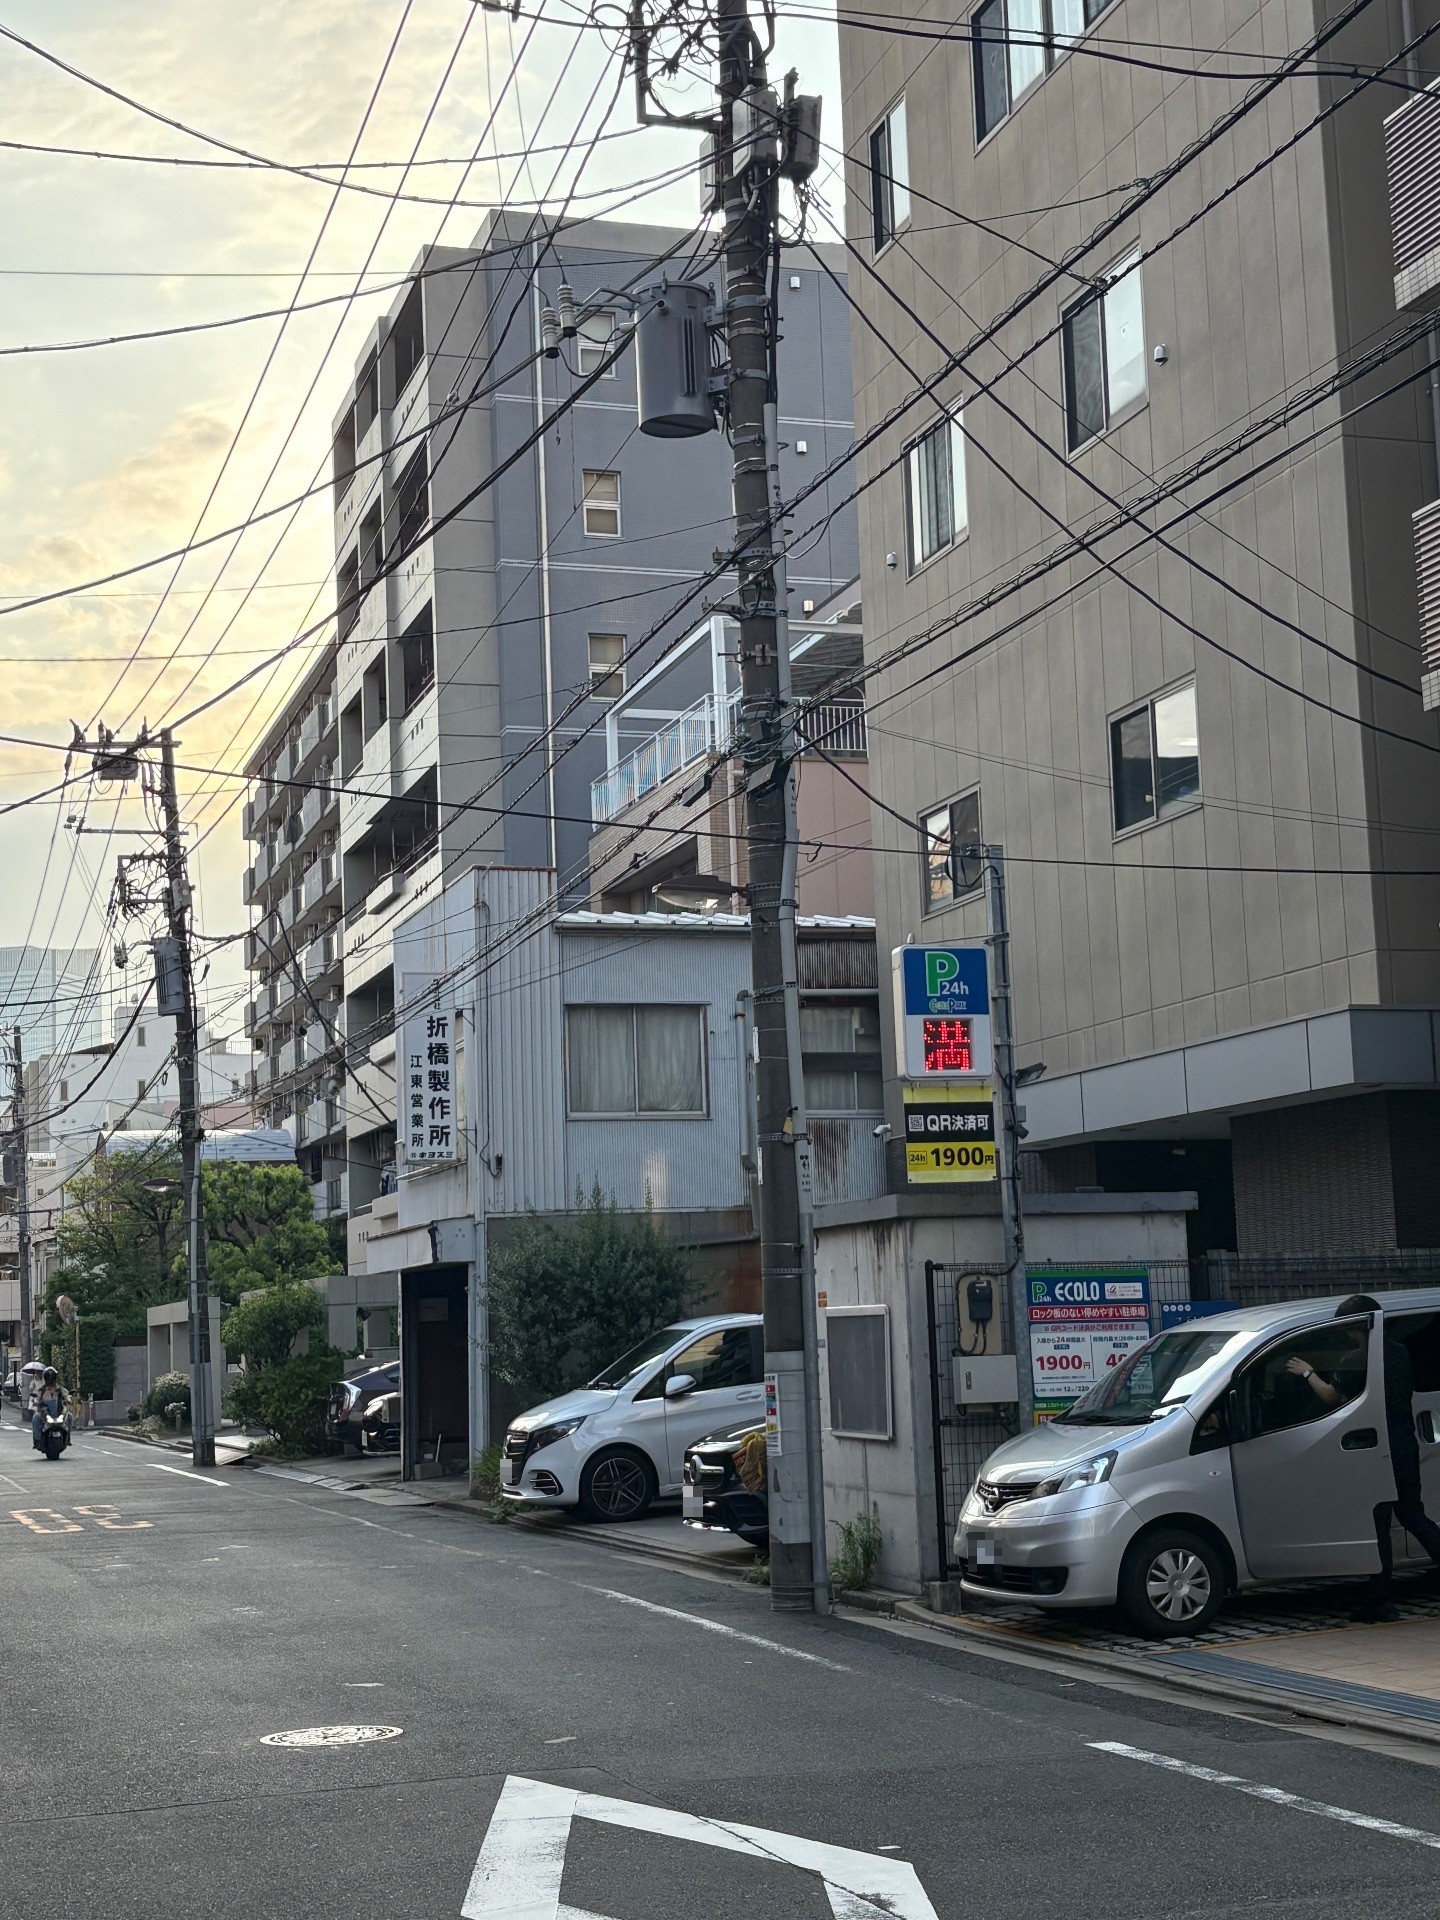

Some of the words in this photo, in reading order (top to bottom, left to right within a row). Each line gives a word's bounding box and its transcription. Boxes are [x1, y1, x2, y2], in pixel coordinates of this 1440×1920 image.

[925, 951, 959, 996] P
[941, 981, 969, 995] 24h
[924, 1021, 970, 1072] 満
[427, 1015, 450, 1147] 折橋製作所
[410, 1054, 424, 1147] 江東営業所
[926, 1114, 989, 1131] QR決済可
[910, 1153, 926, 1162] 24h
[930, 1147, 994, 1167] 1900円
[1032, 1281, 1047, 1303] P
[1054, 1281, 1100, 1302] ECOLO
[1032, 1306, 1146, 1318] ロック板のない停めやすい駐車場
[1035, 1354, 1091, 1371] 1900円
